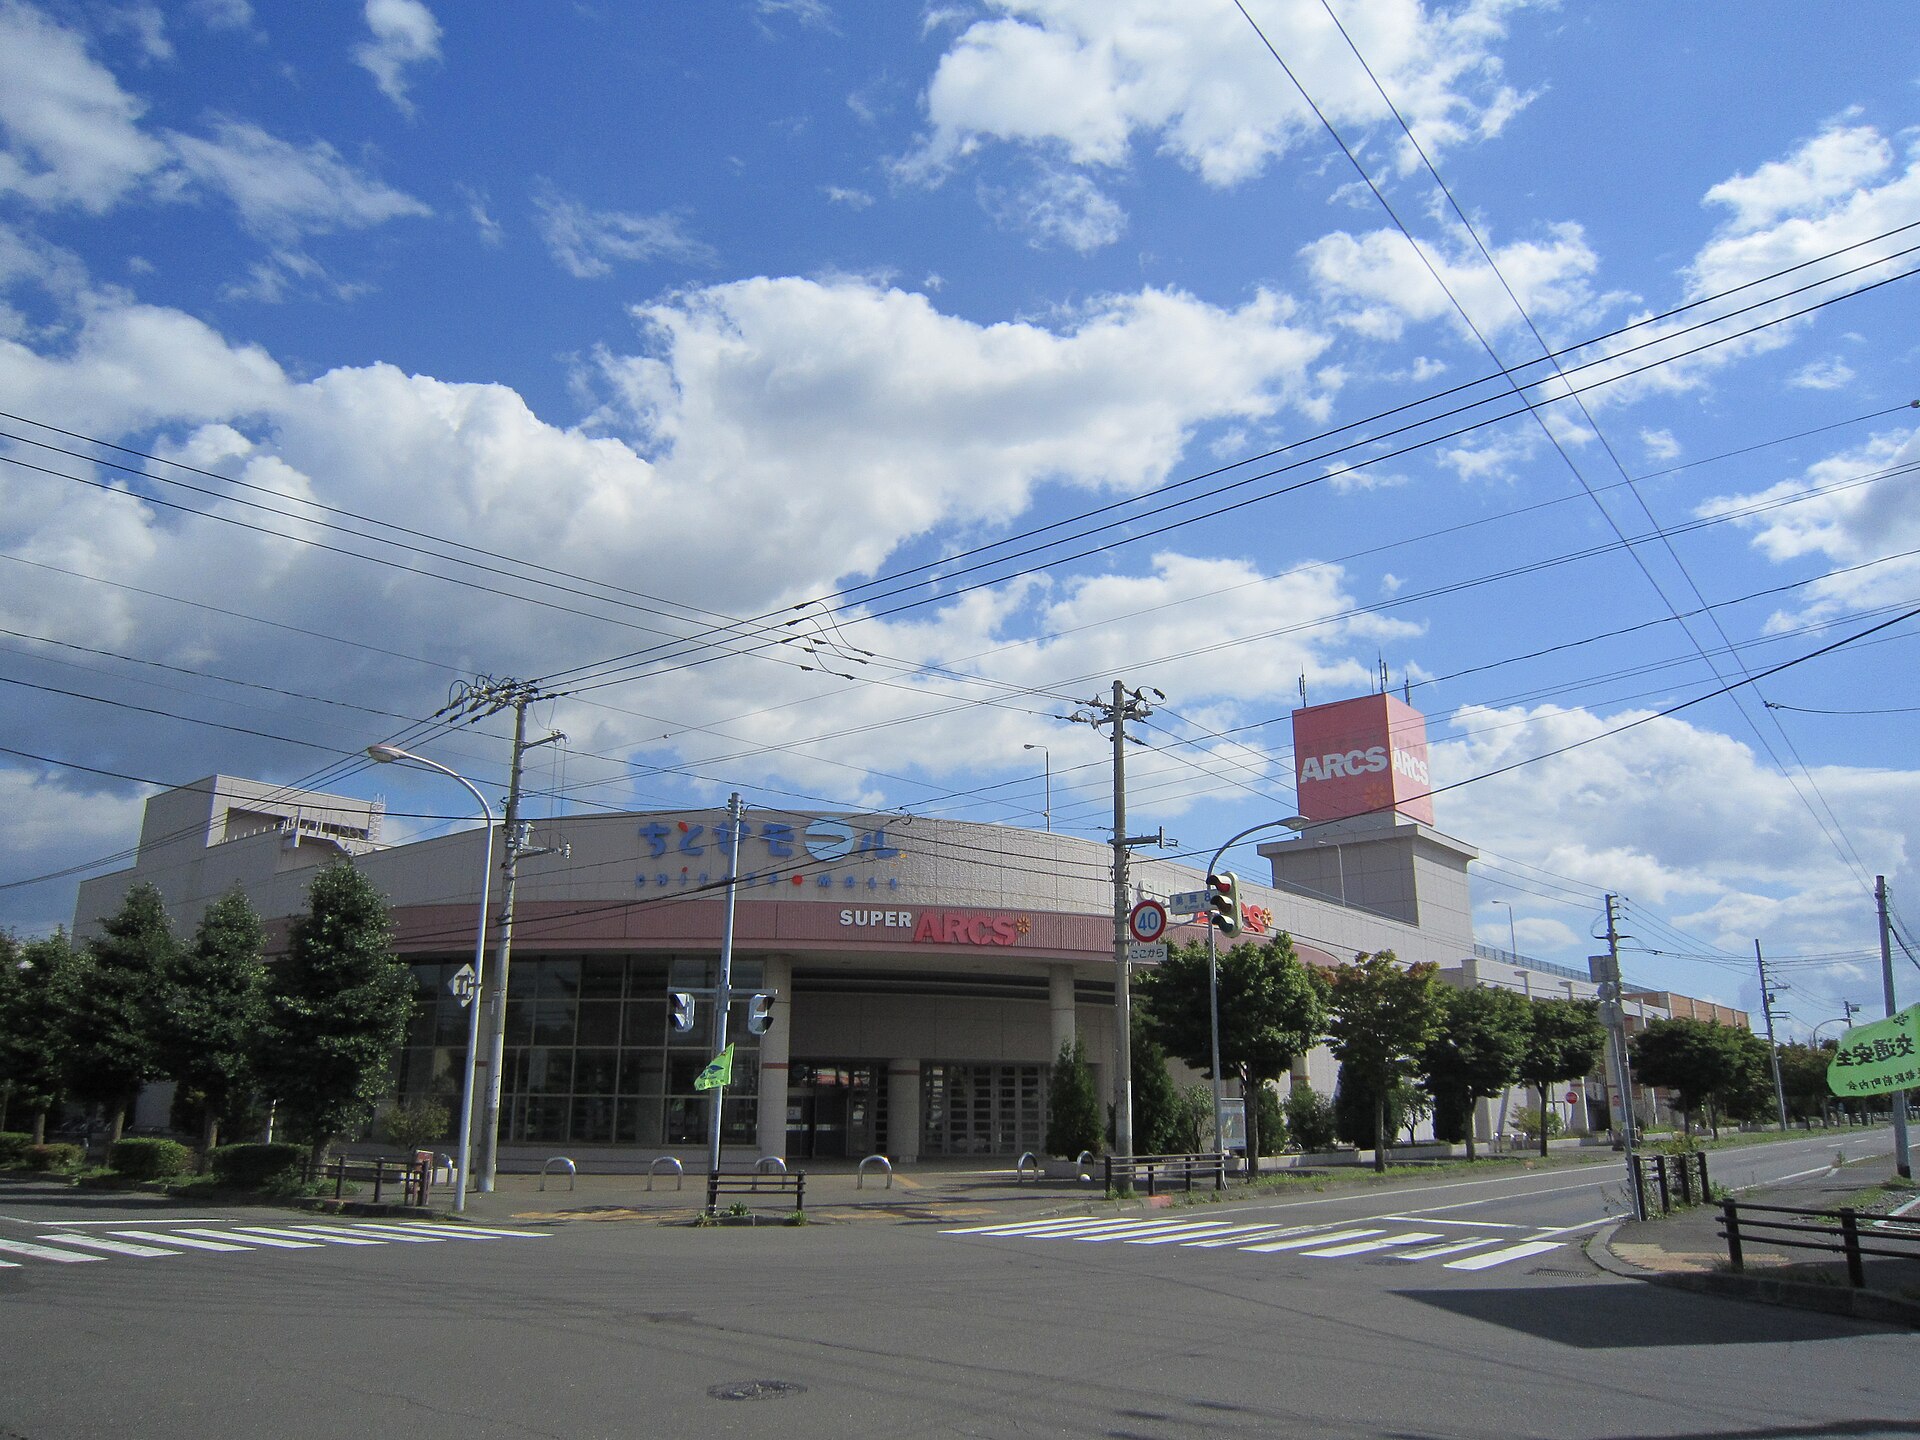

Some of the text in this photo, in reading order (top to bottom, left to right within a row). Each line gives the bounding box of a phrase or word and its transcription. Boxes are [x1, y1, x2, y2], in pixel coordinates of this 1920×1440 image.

[1300, 746, 1387, 783] ARCS
[1393, 749, 1429, 785] ARCS
[840, 909, 1018, 945] SUPER ARCS
[1137, 911, 1158, 931] 40
[1131, 948, 1164, 959] ここから
